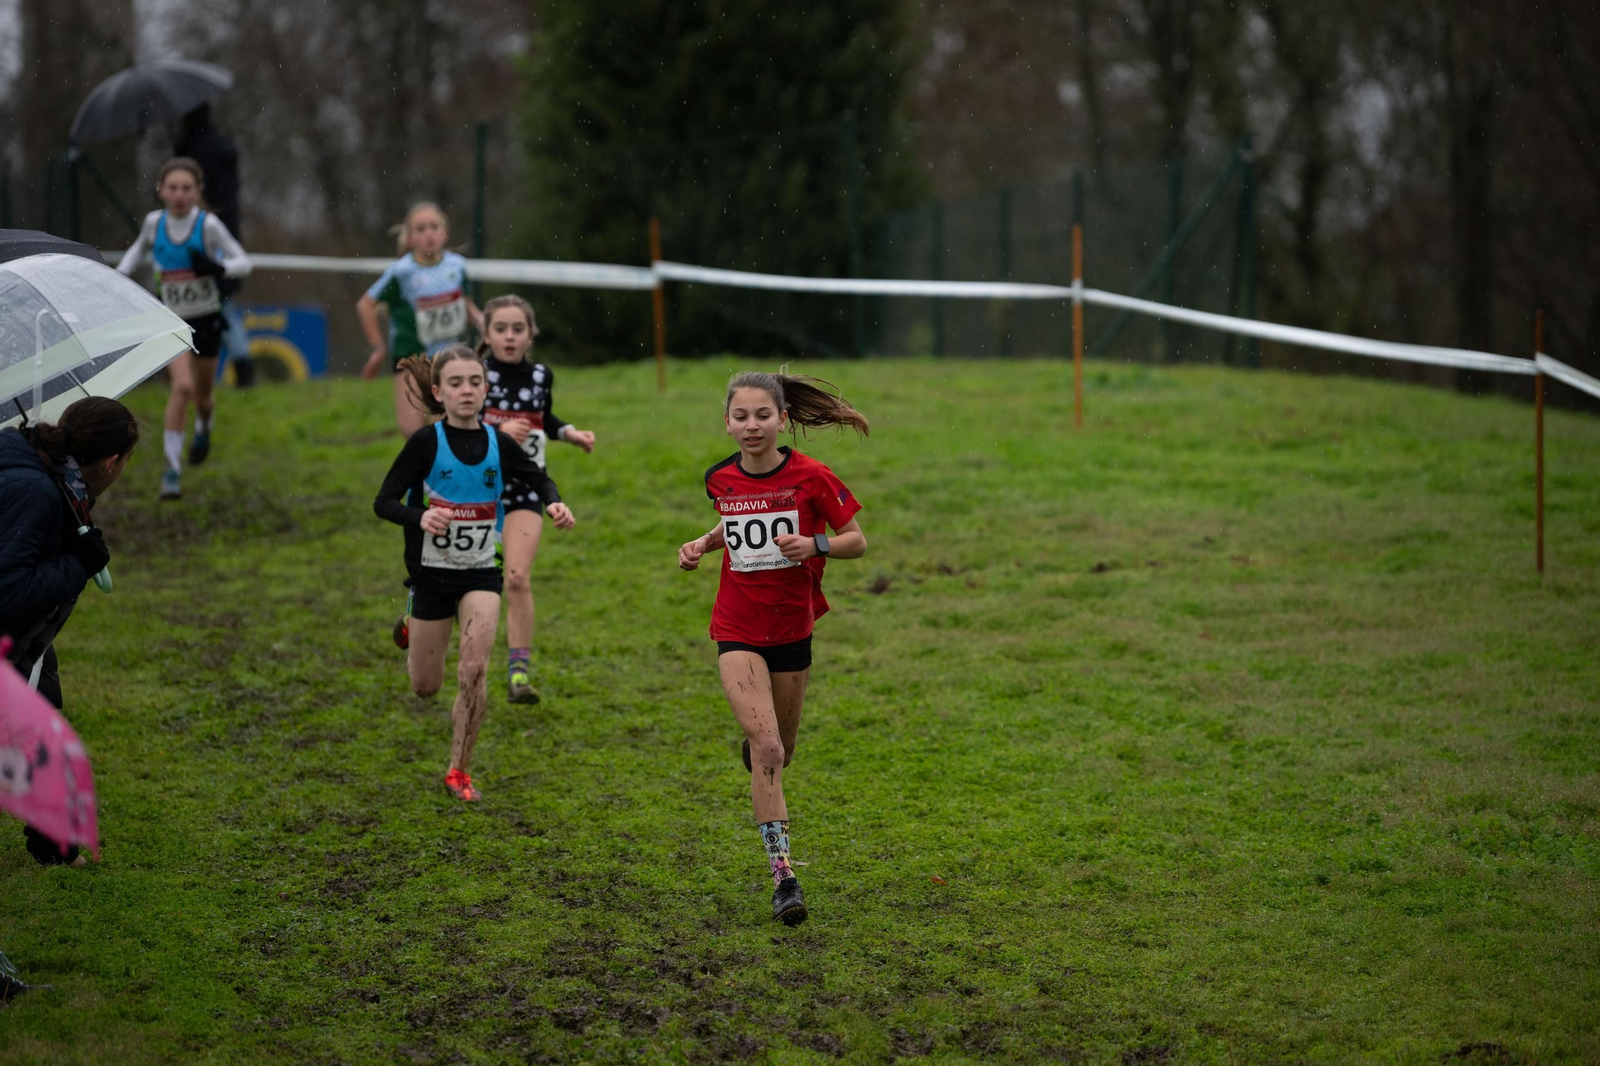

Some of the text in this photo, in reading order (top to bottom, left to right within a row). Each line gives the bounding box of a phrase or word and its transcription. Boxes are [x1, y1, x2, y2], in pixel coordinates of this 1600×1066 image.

[528, 434, 539, 458] 3
[771, 498, 795, 508] 2026
[432, 525, 492, 551] 857
[725, 517, 794, 551] 500
